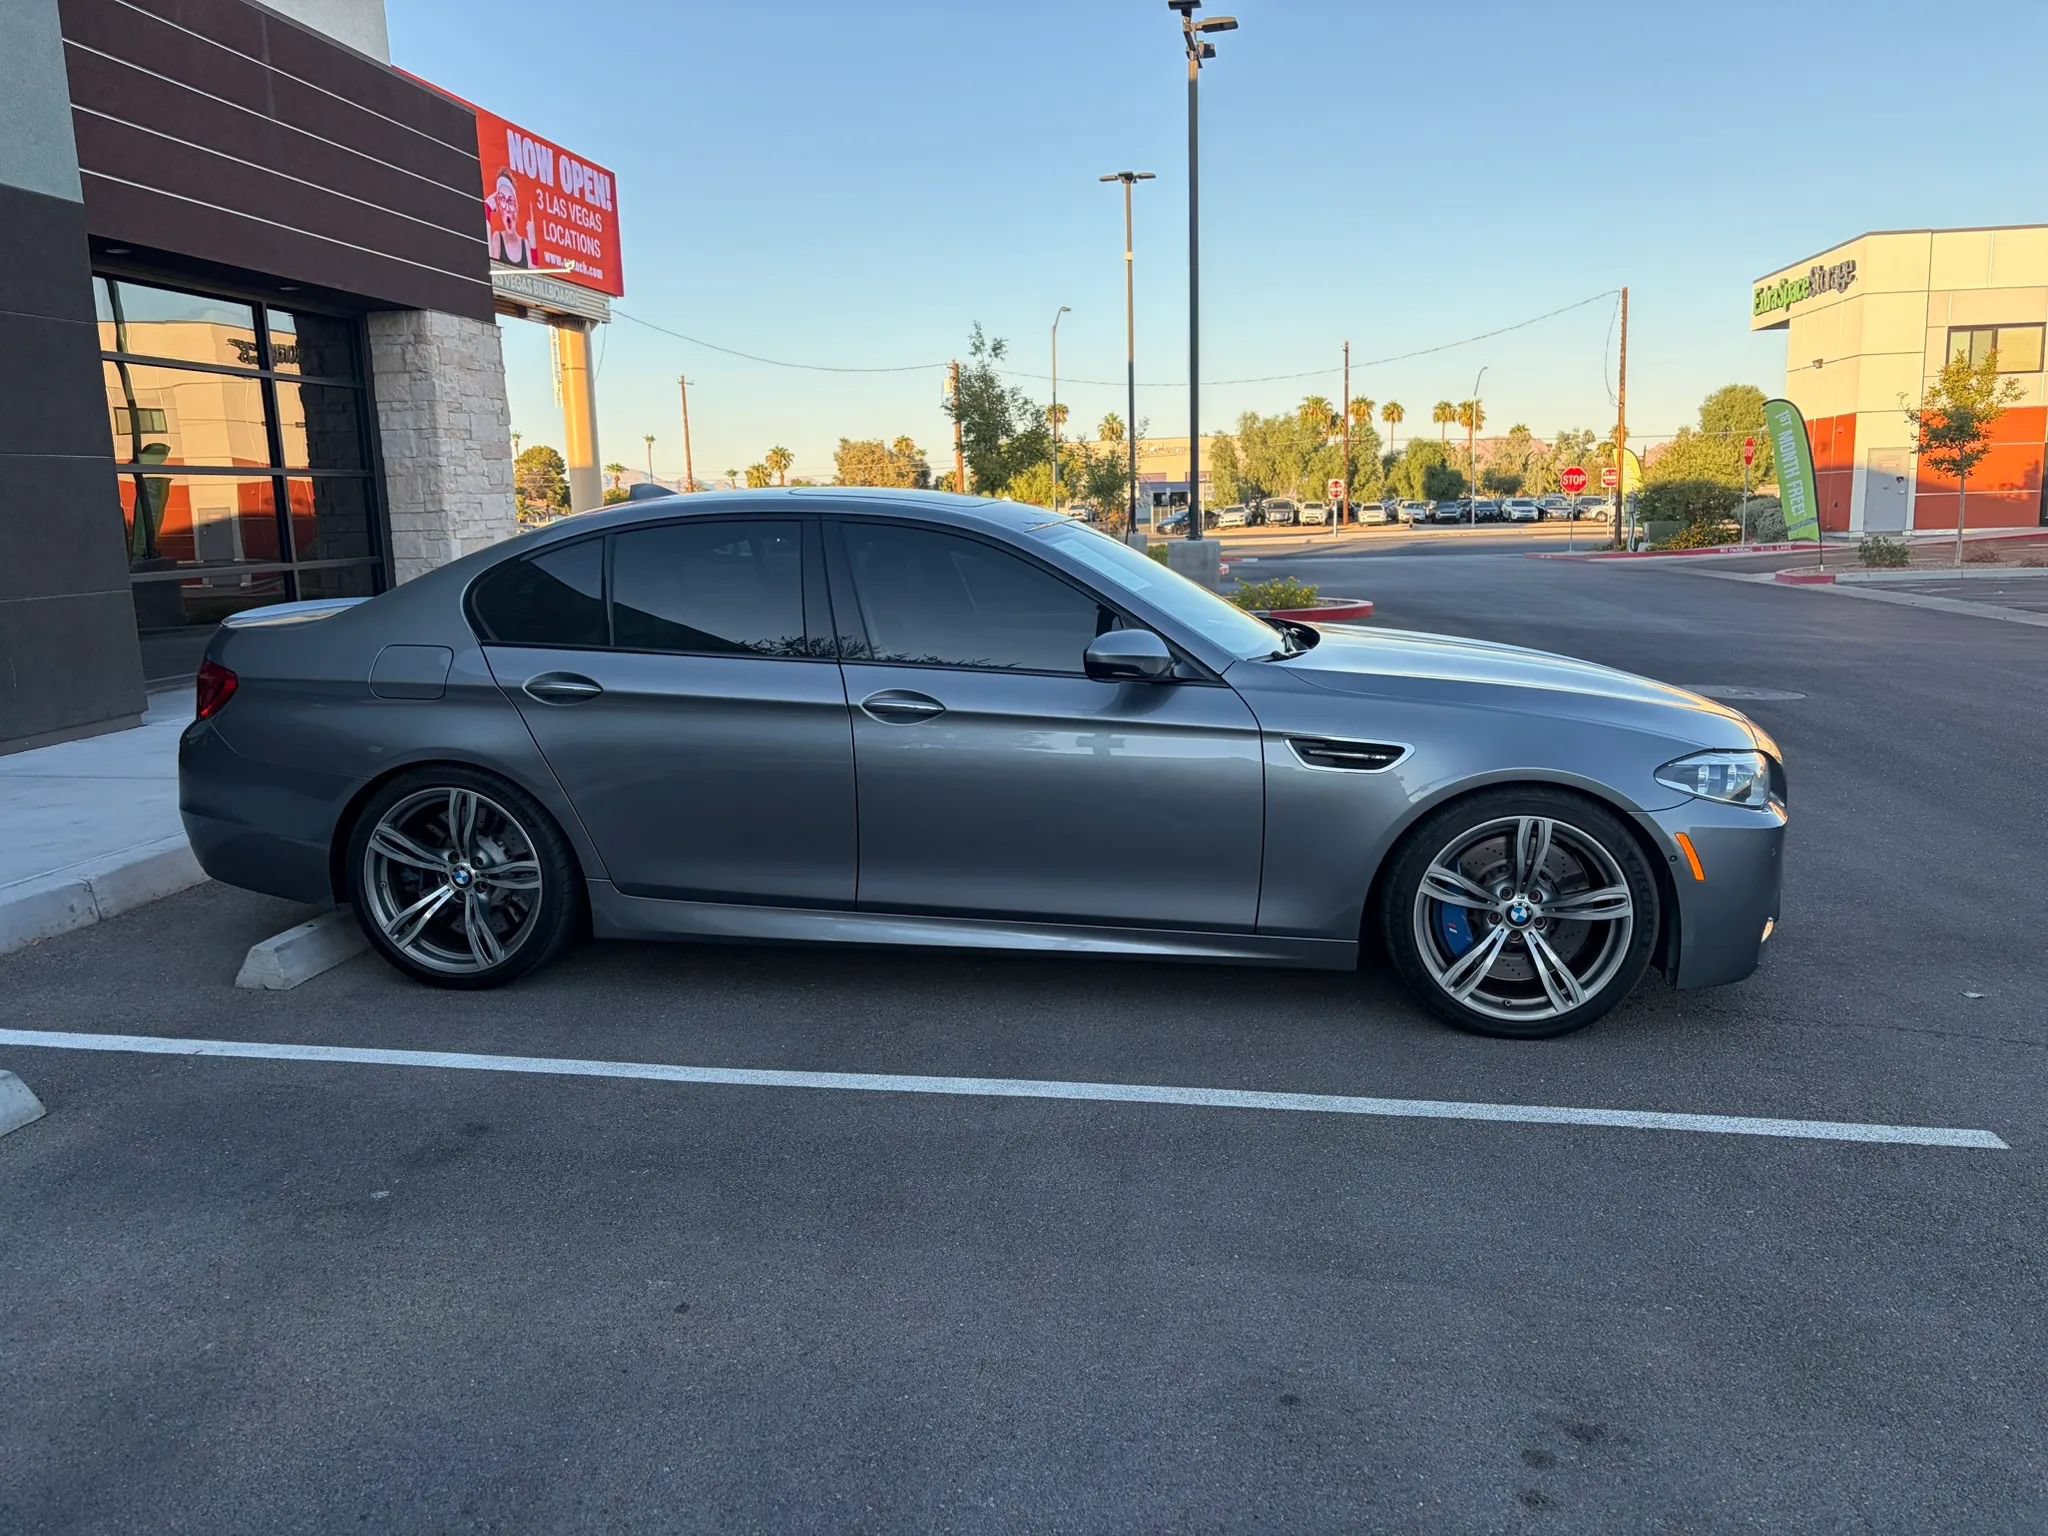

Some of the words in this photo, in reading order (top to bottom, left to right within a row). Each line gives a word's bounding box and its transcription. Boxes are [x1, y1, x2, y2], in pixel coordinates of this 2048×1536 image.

[507, 129, 554, 186] NOW
[560, 155, 612, 212] OPEN!
[536, 188, 544, 210] 3
[546, 192, 567, 219] LAS
[568, 201, 602, 232] VEGAS
[543, 219, 601, 258] LOCATIONS
[505, 275, 532, 294] VEGAS
[1777, 429, 1800, 478] MONTH
[1563, 475, 1585, 485] STOP
